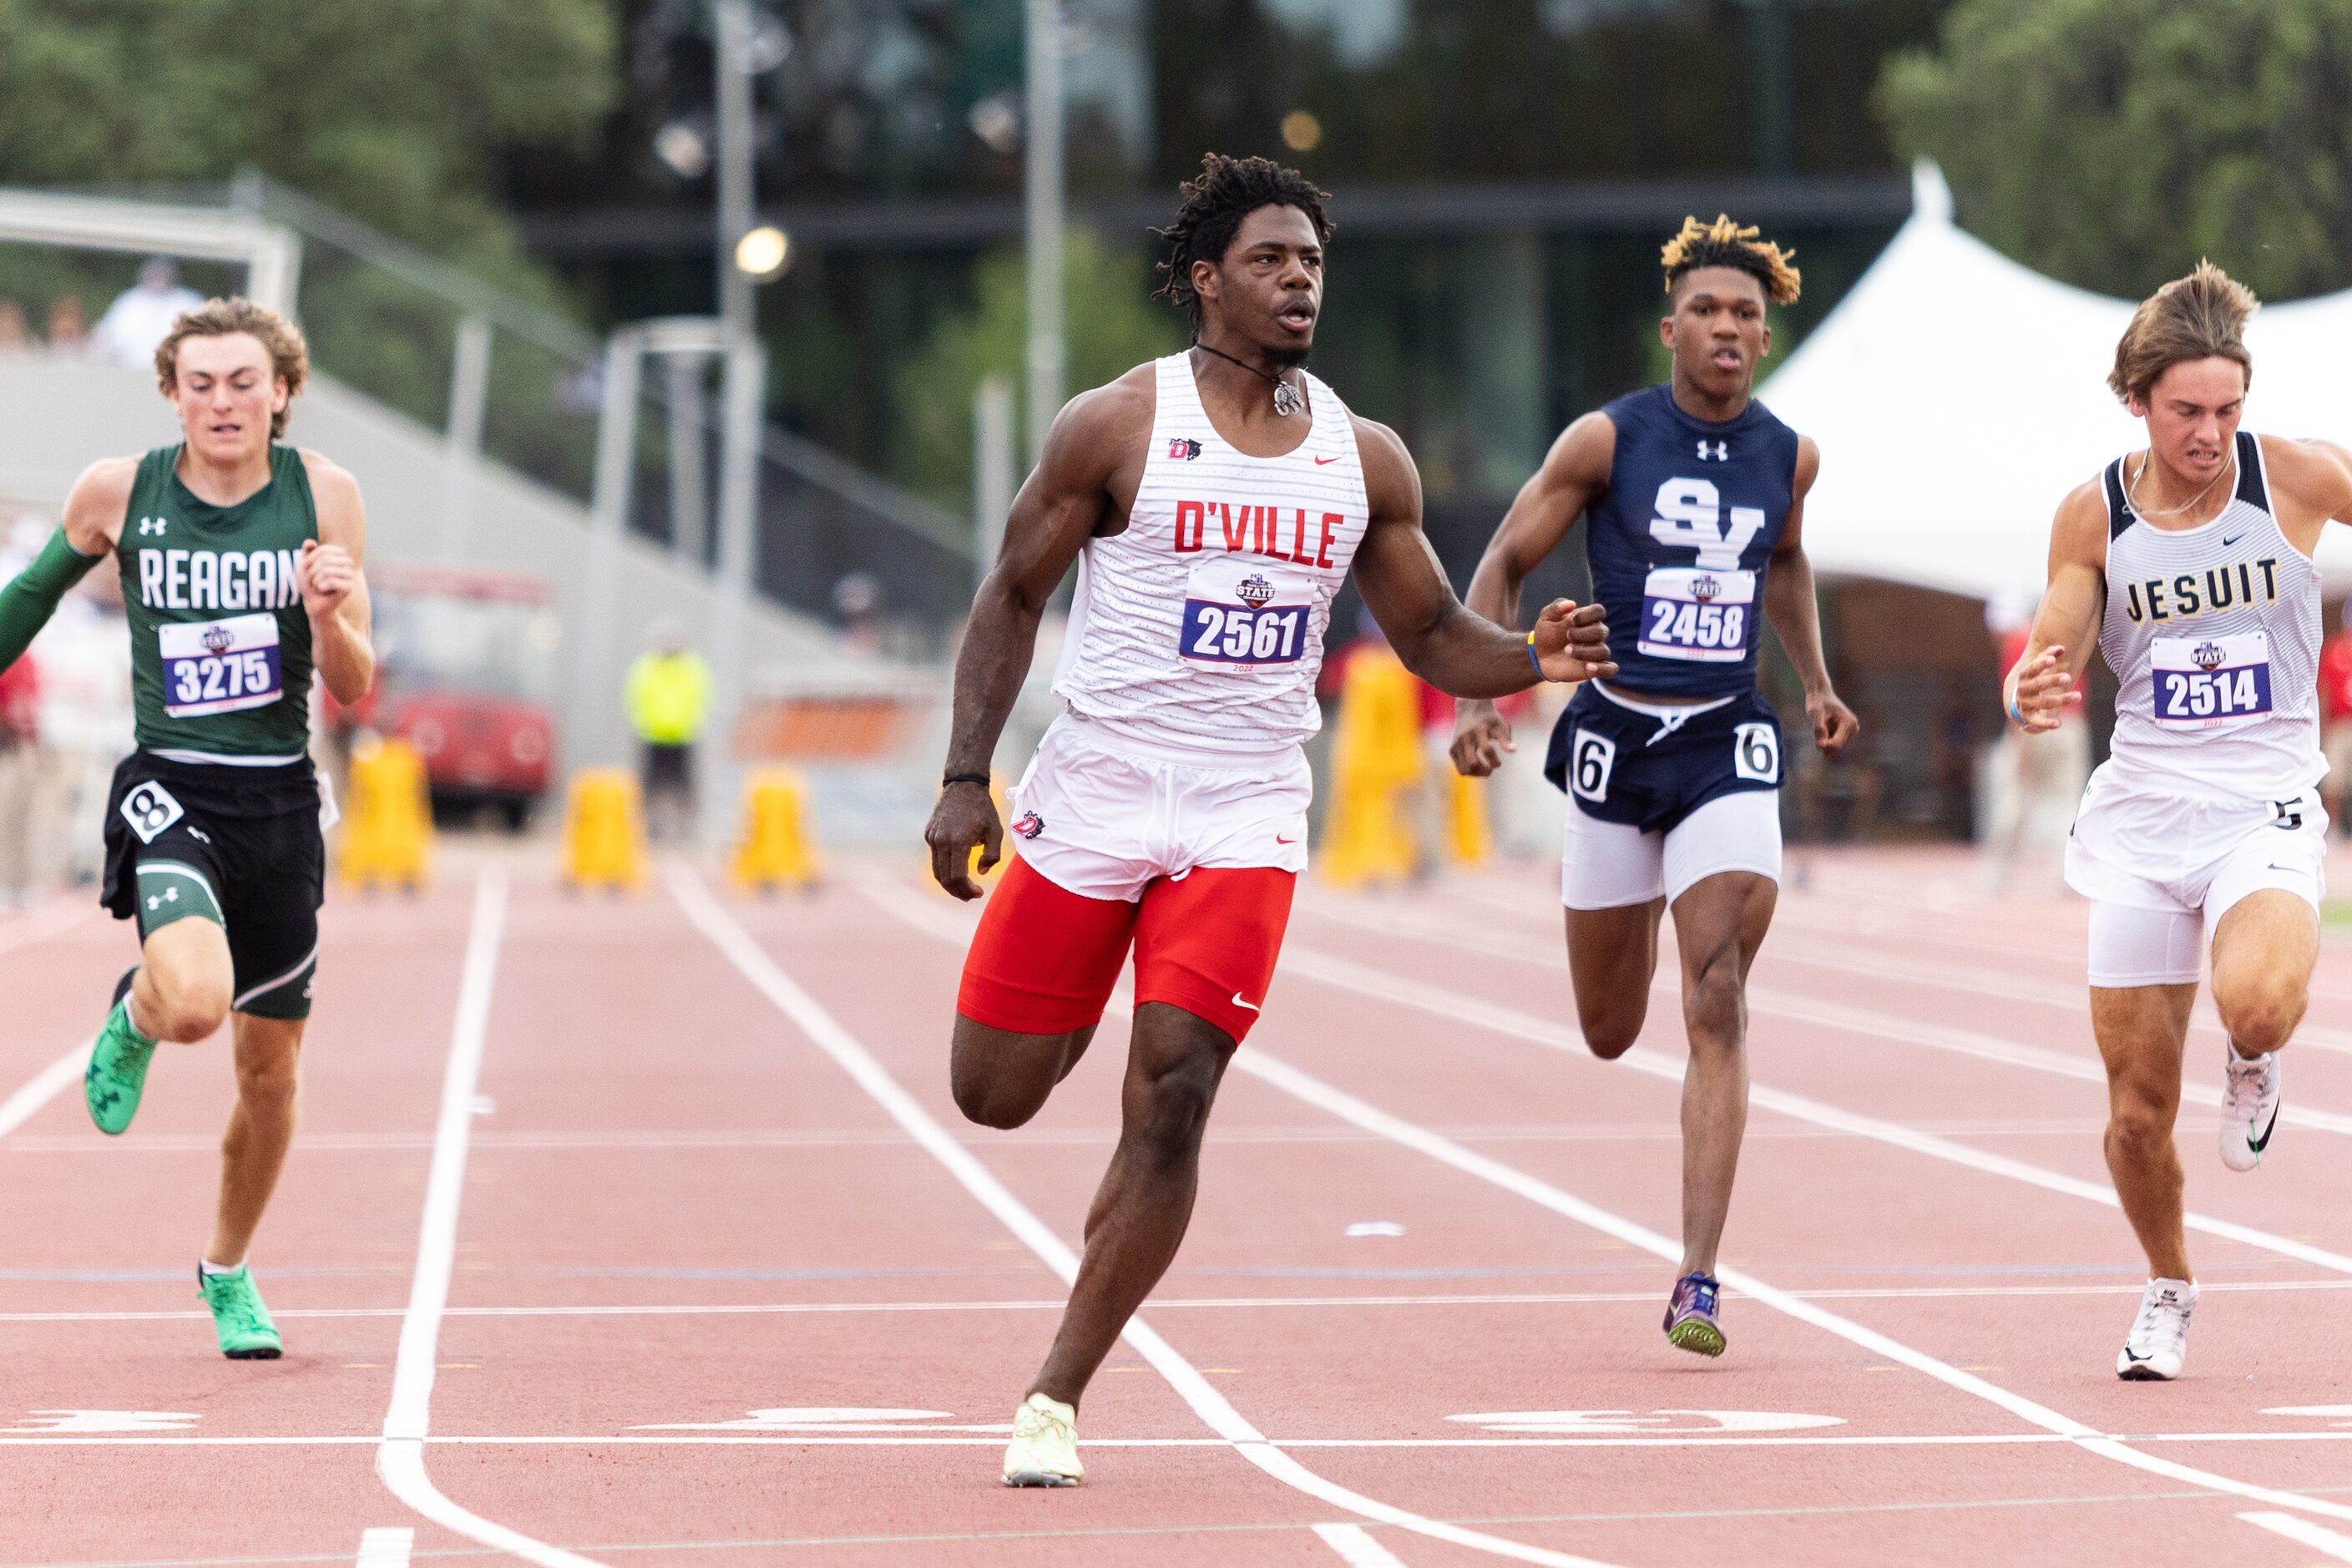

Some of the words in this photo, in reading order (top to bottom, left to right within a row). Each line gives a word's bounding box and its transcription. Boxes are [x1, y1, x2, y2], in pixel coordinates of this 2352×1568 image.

[1174, 500, 1344, 569] D'VILLE
[139, 548, 301, 610] REAGAN
[1236, 585, 1275, 598] STATE
[2127, 558, 2280, 625] JESUIT
[1193, 606, 1298, 659] 2561
[1648, 599, 1744, 648] 2458
[173, 650, 271, 703] 3275
[2165, 669, 2258, 716] 2514
[1578, 739, 1606, 792] 6
[1743, 727, 1773, 774] 6
[132, 789, 169, 832] 8
